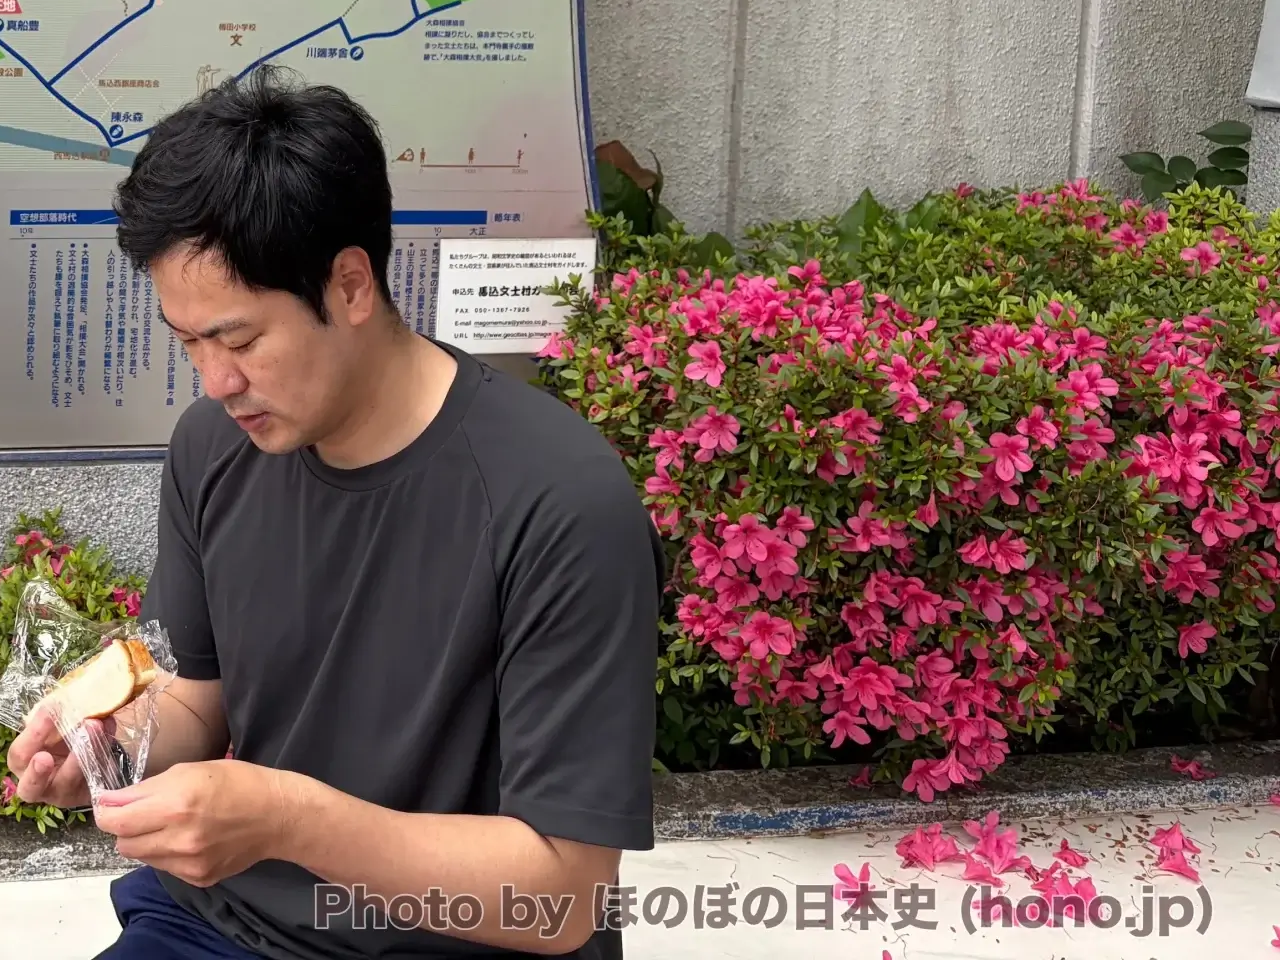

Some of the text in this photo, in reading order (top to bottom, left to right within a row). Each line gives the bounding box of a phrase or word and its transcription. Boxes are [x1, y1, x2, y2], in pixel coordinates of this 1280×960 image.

[6, 20, 39, 32] 真船豊
[111, 112, 143, 123] 陳永森
